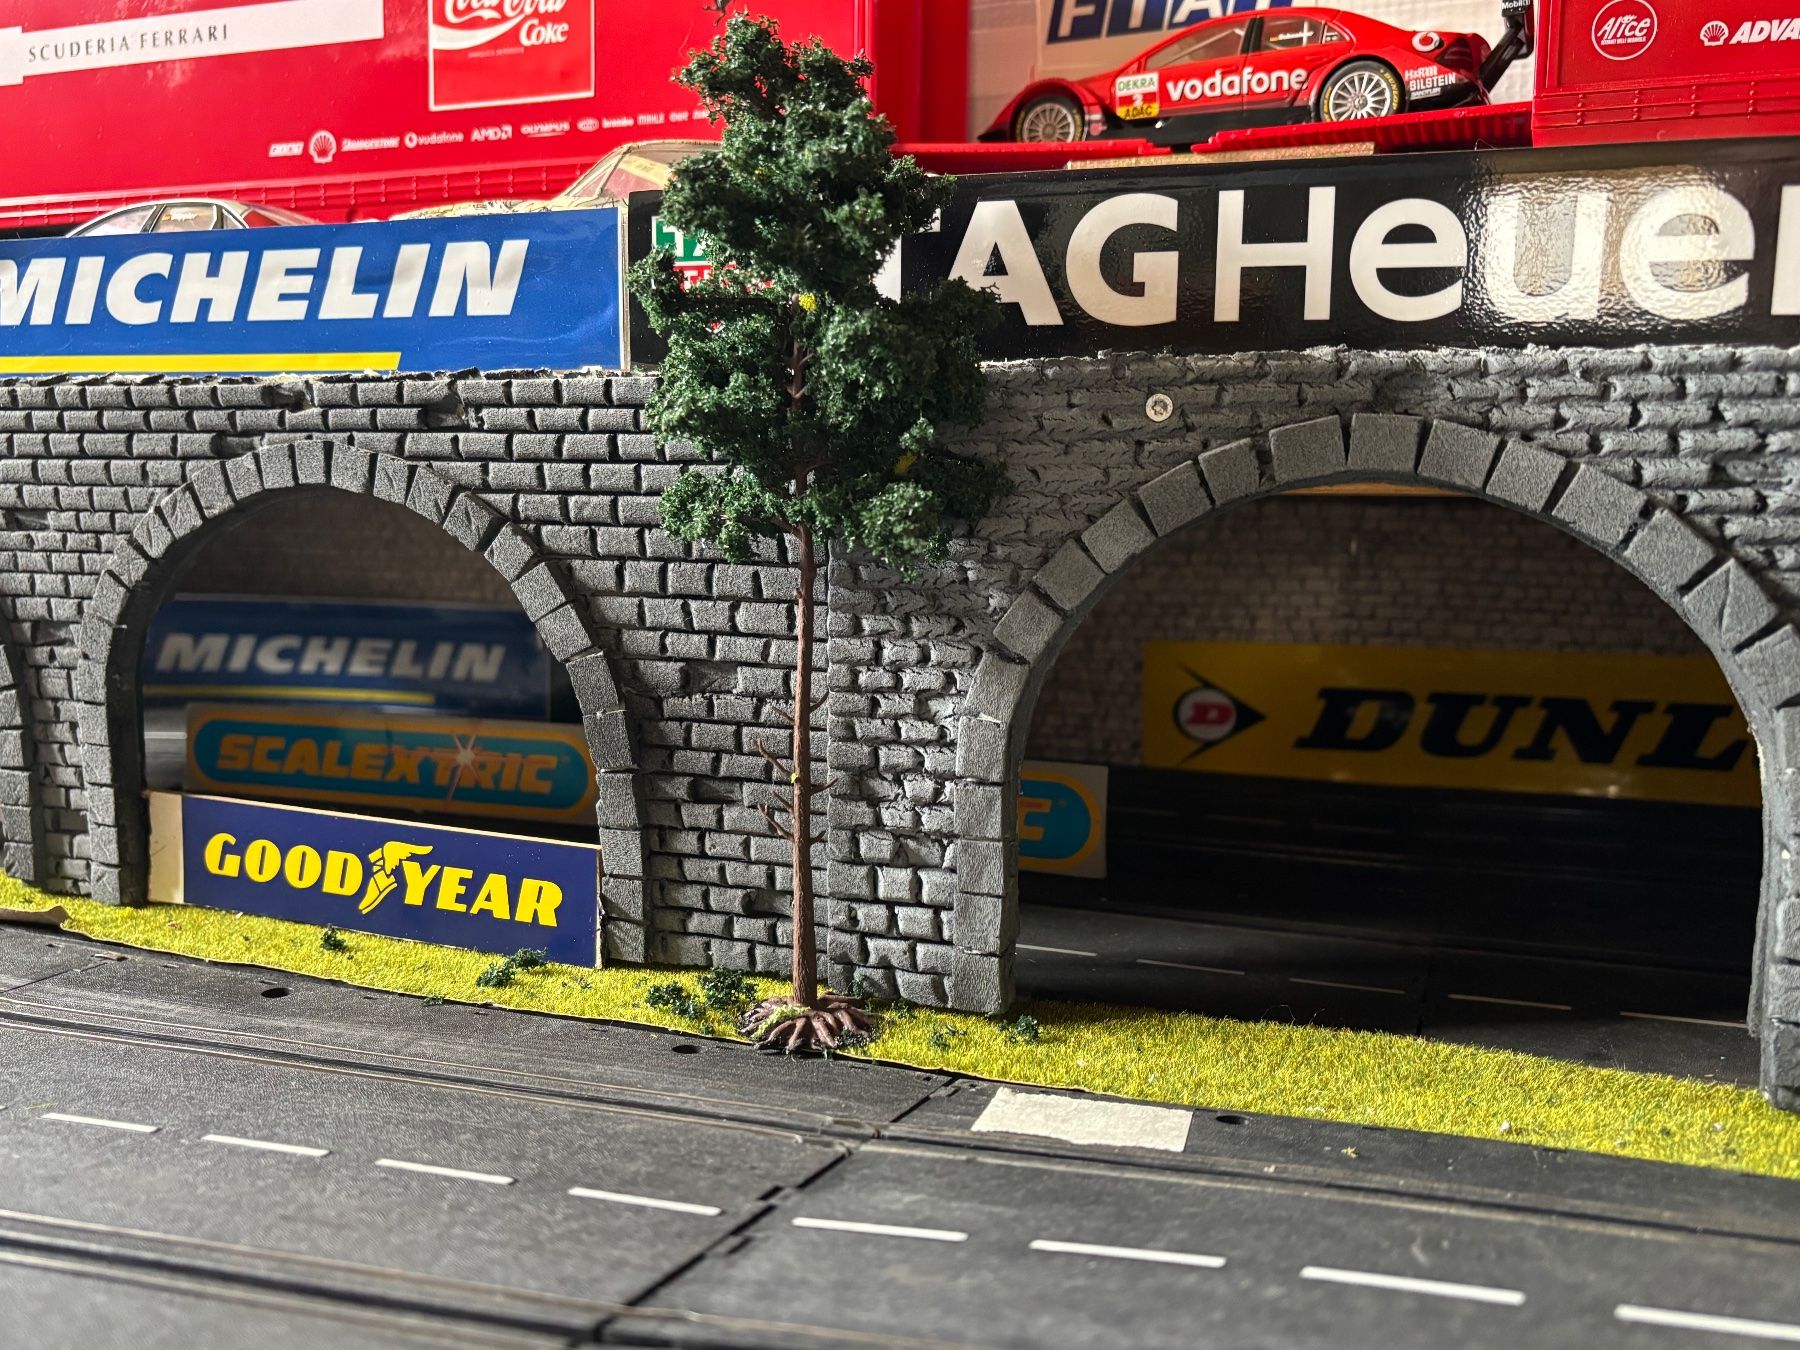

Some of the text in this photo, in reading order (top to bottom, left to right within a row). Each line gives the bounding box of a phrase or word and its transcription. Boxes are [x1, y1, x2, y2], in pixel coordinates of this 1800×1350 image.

[519, 18, 569, 47] Coke
[1597, 14, 1651, 40] Alice
[28, 23, 229, 63] SCUDERIA FERRARI
[1118, 77, 1156, 91] DEKRA
[1166, 67, 1309, 102] vodafone
[1410, 72, 1456, 92] BILSTEIN
[1124, 105, 1153, 119] ADAC
[1132, 93, 1144, 106] 2
[471, 125, 502, 142] AMD
[520, 121, 570, 136] OLYMPUS
[0, 238, 530, 327] MICHELIN
[156, 632, 507, 683] MICHELIN
[217, 733, 559, 795] SCALEXTRIC
